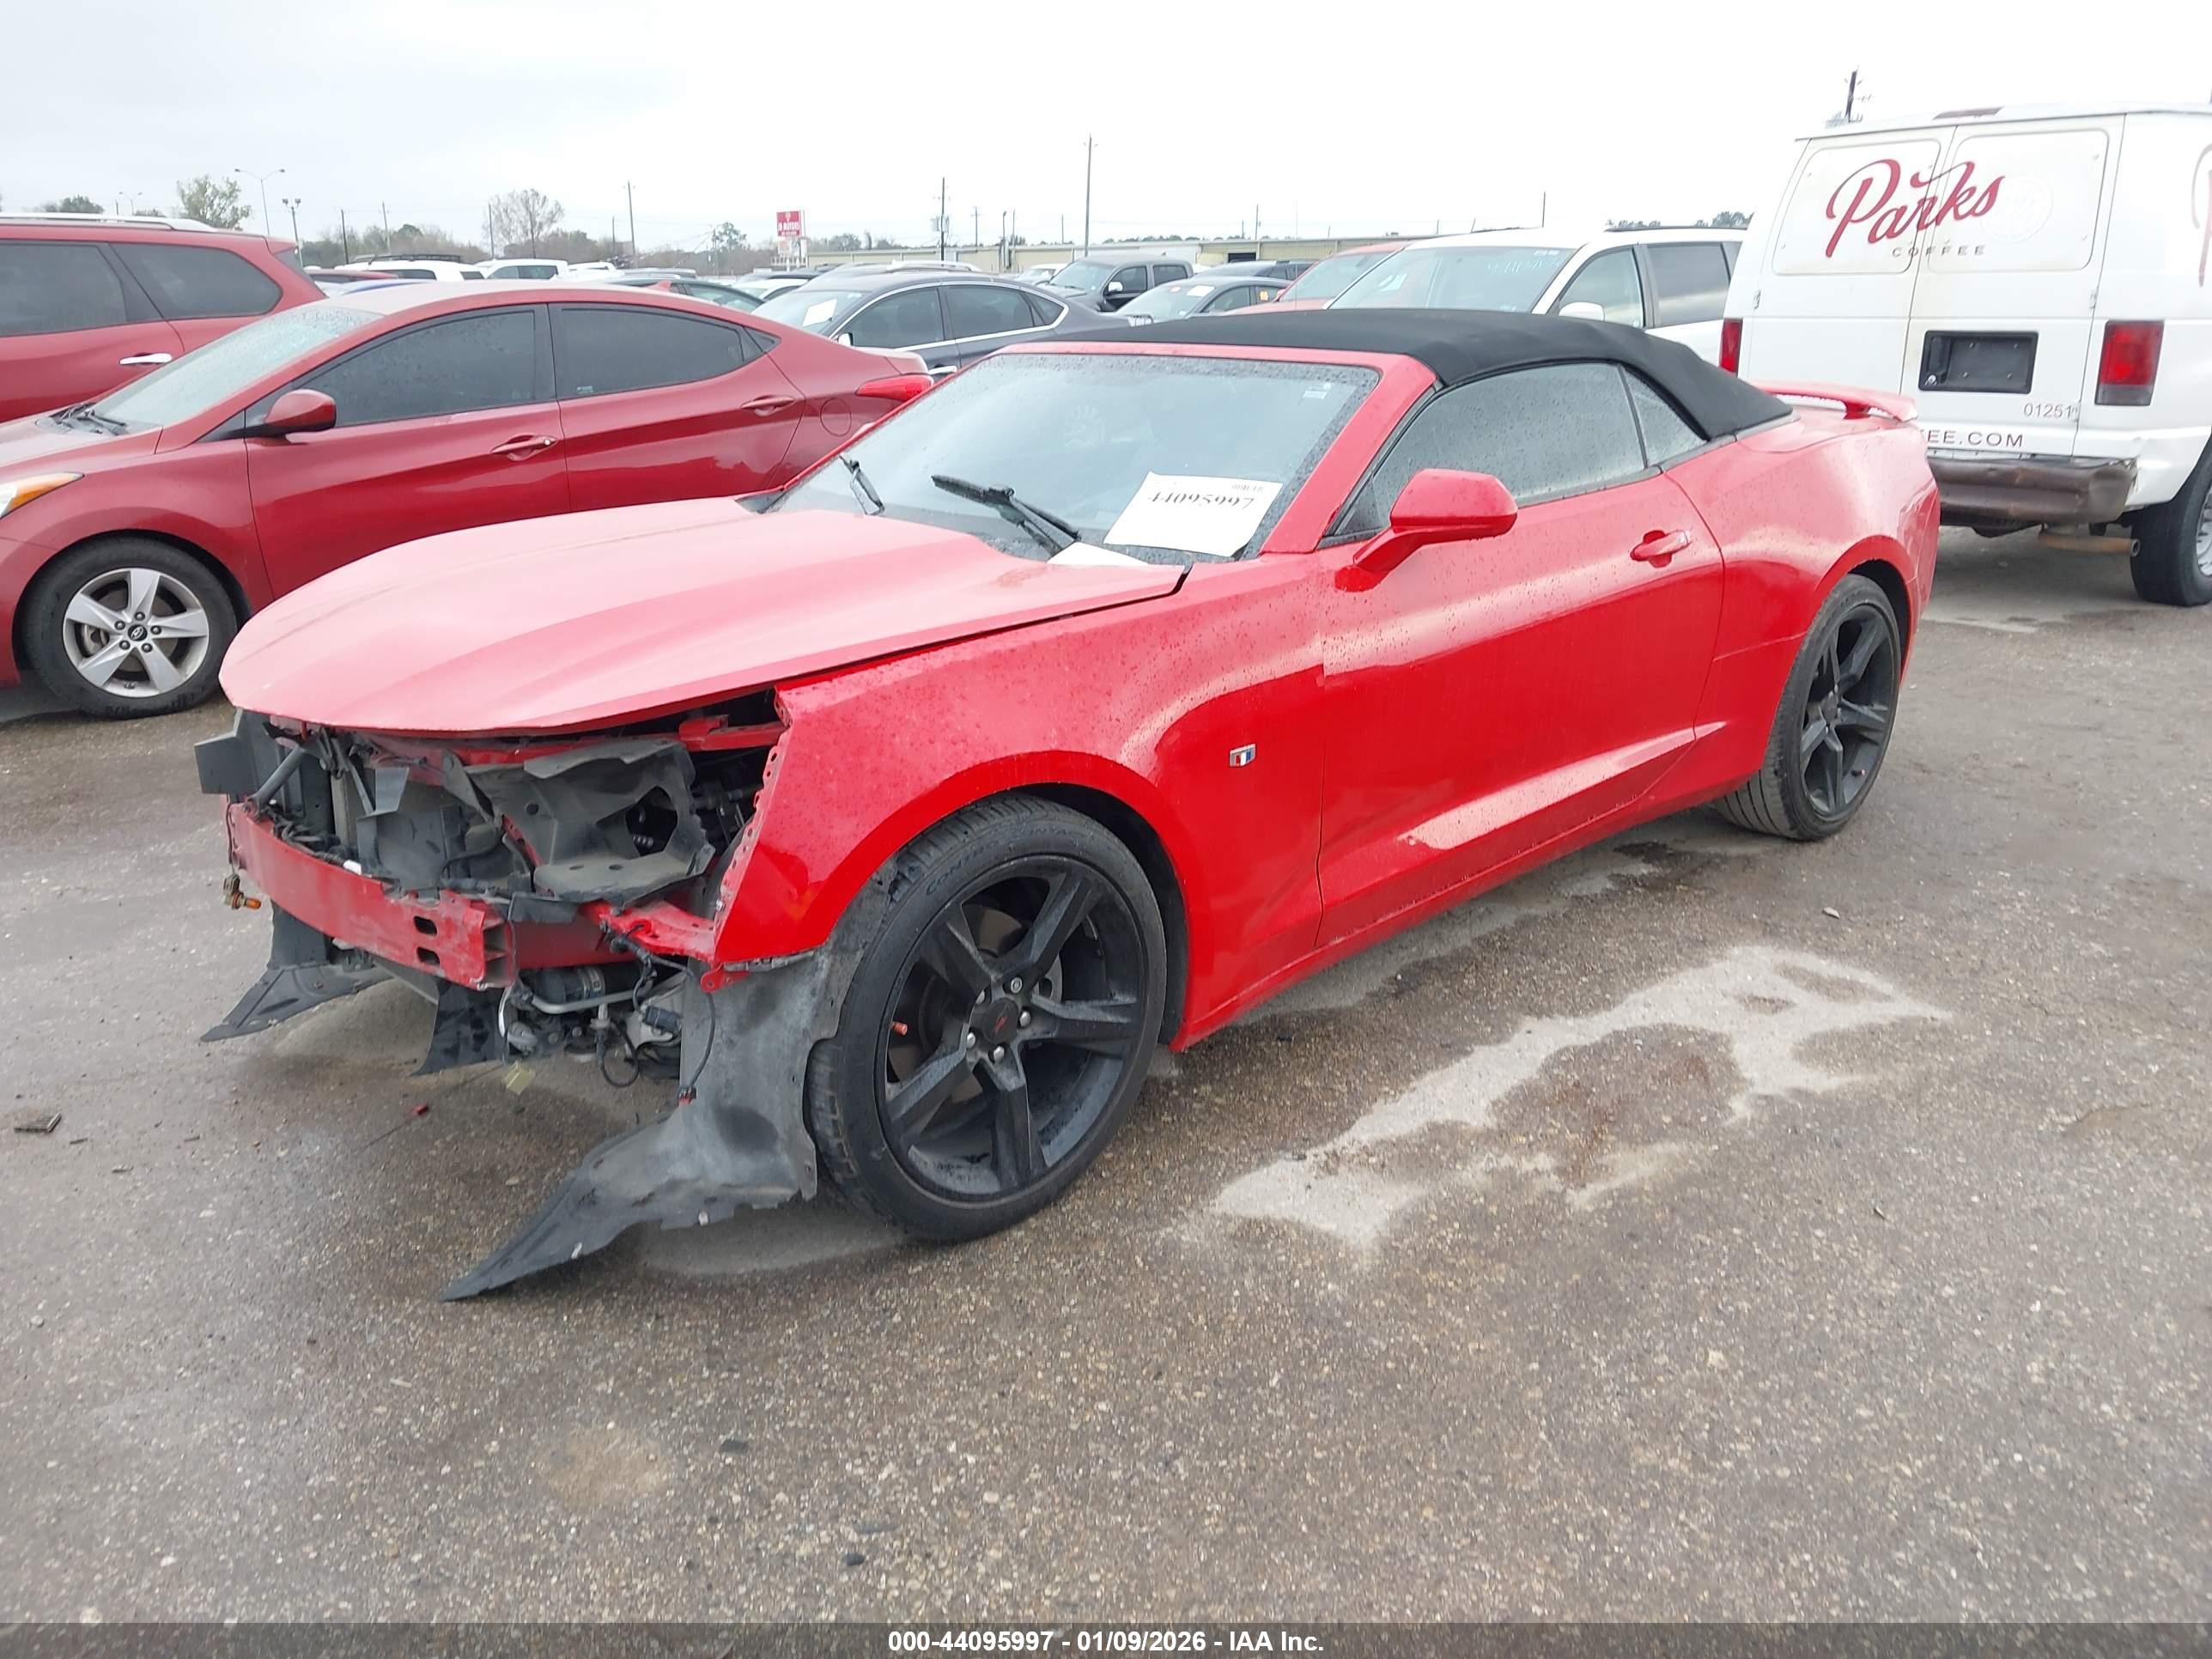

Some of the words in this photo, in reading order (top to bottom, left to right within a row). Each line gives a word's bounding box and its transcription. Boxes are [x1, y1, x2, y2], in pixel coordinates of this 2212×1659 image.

[1826, 158, 2006, 258] Parks
[1892, 245, 1985, 258] COFFEE
[1921, 429, 2023, 447] EE.COM
[1148, 491, 1255, 509] 44095997
